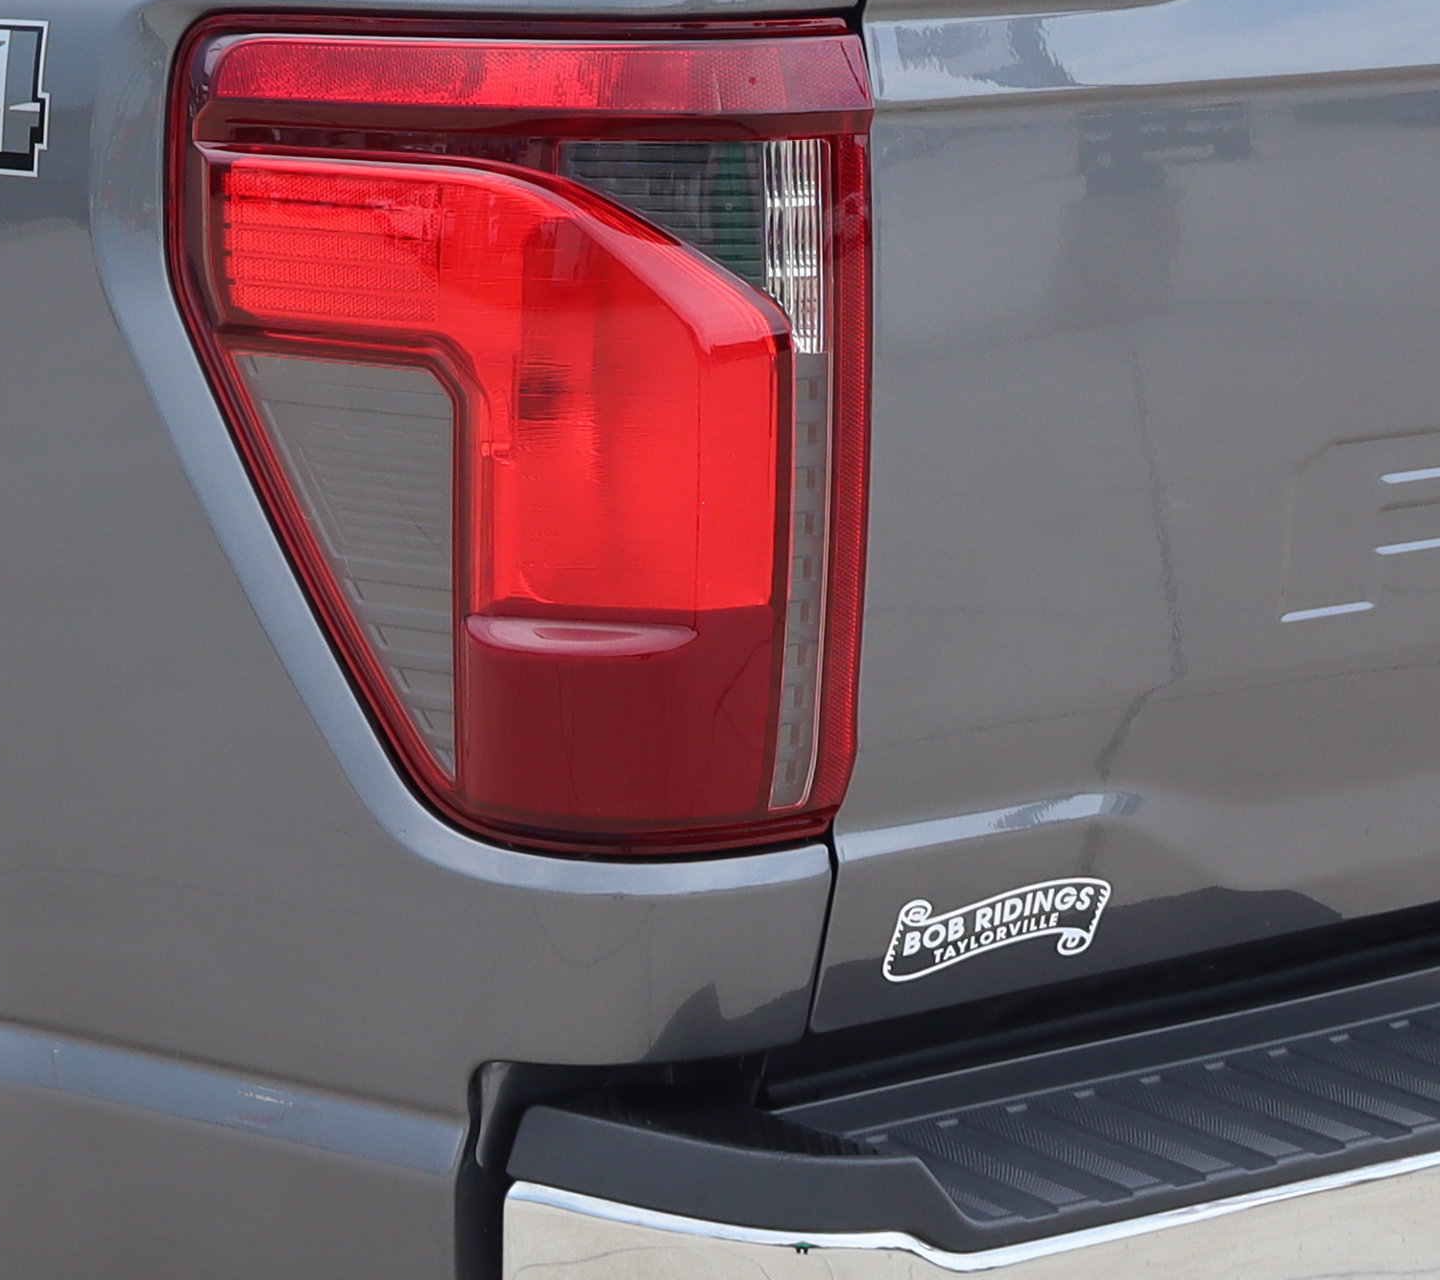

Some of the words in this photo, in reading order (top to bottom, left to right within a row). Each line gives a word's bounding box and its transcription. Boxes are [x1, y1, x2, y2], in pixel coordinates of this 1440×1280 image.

[902, 916, 965, 957] BOB
[974, 886, 1095, 933] RIDINGS
[933, 912, 1060, 964] TAYLORVILLE
